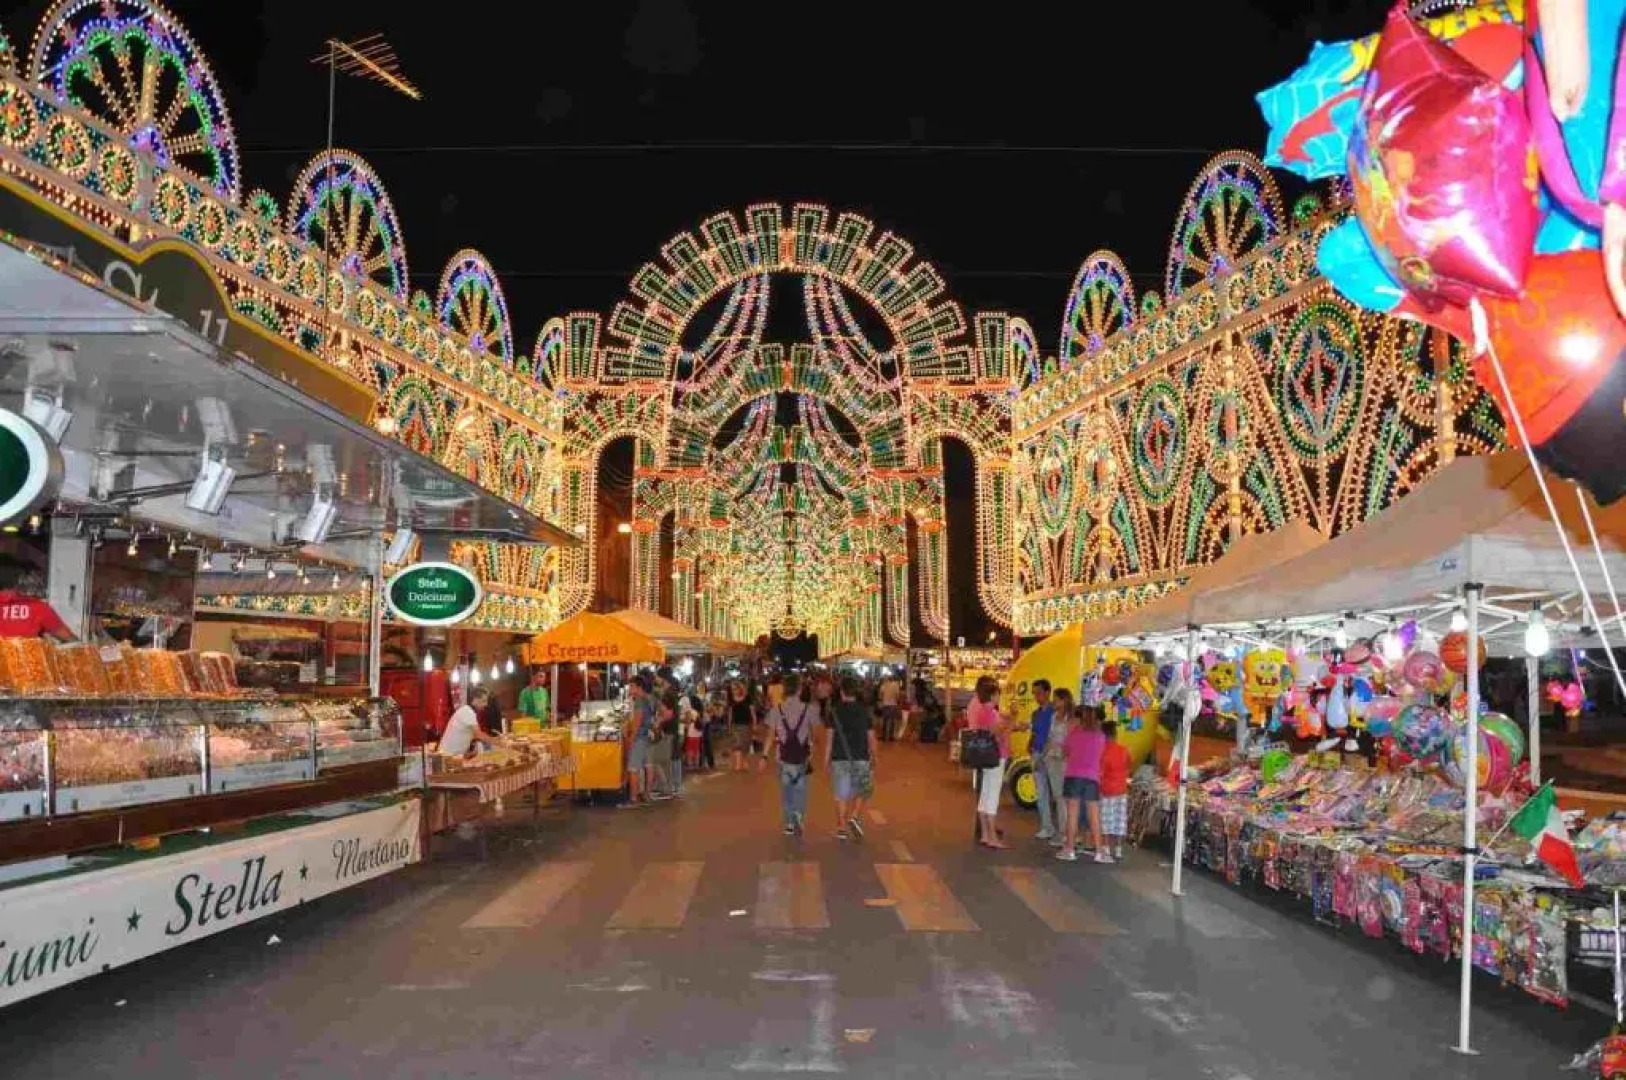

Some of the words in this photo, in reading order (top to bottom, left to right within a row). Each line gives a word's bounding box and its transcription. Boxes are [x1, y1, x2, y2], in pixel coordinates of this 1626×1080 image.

[418, 577, 448, 589] Stella
[547, 642, 619, 660] Creperia
[165, 855, 284, 936] Stella
[332, 838, 409, 881] Martano
